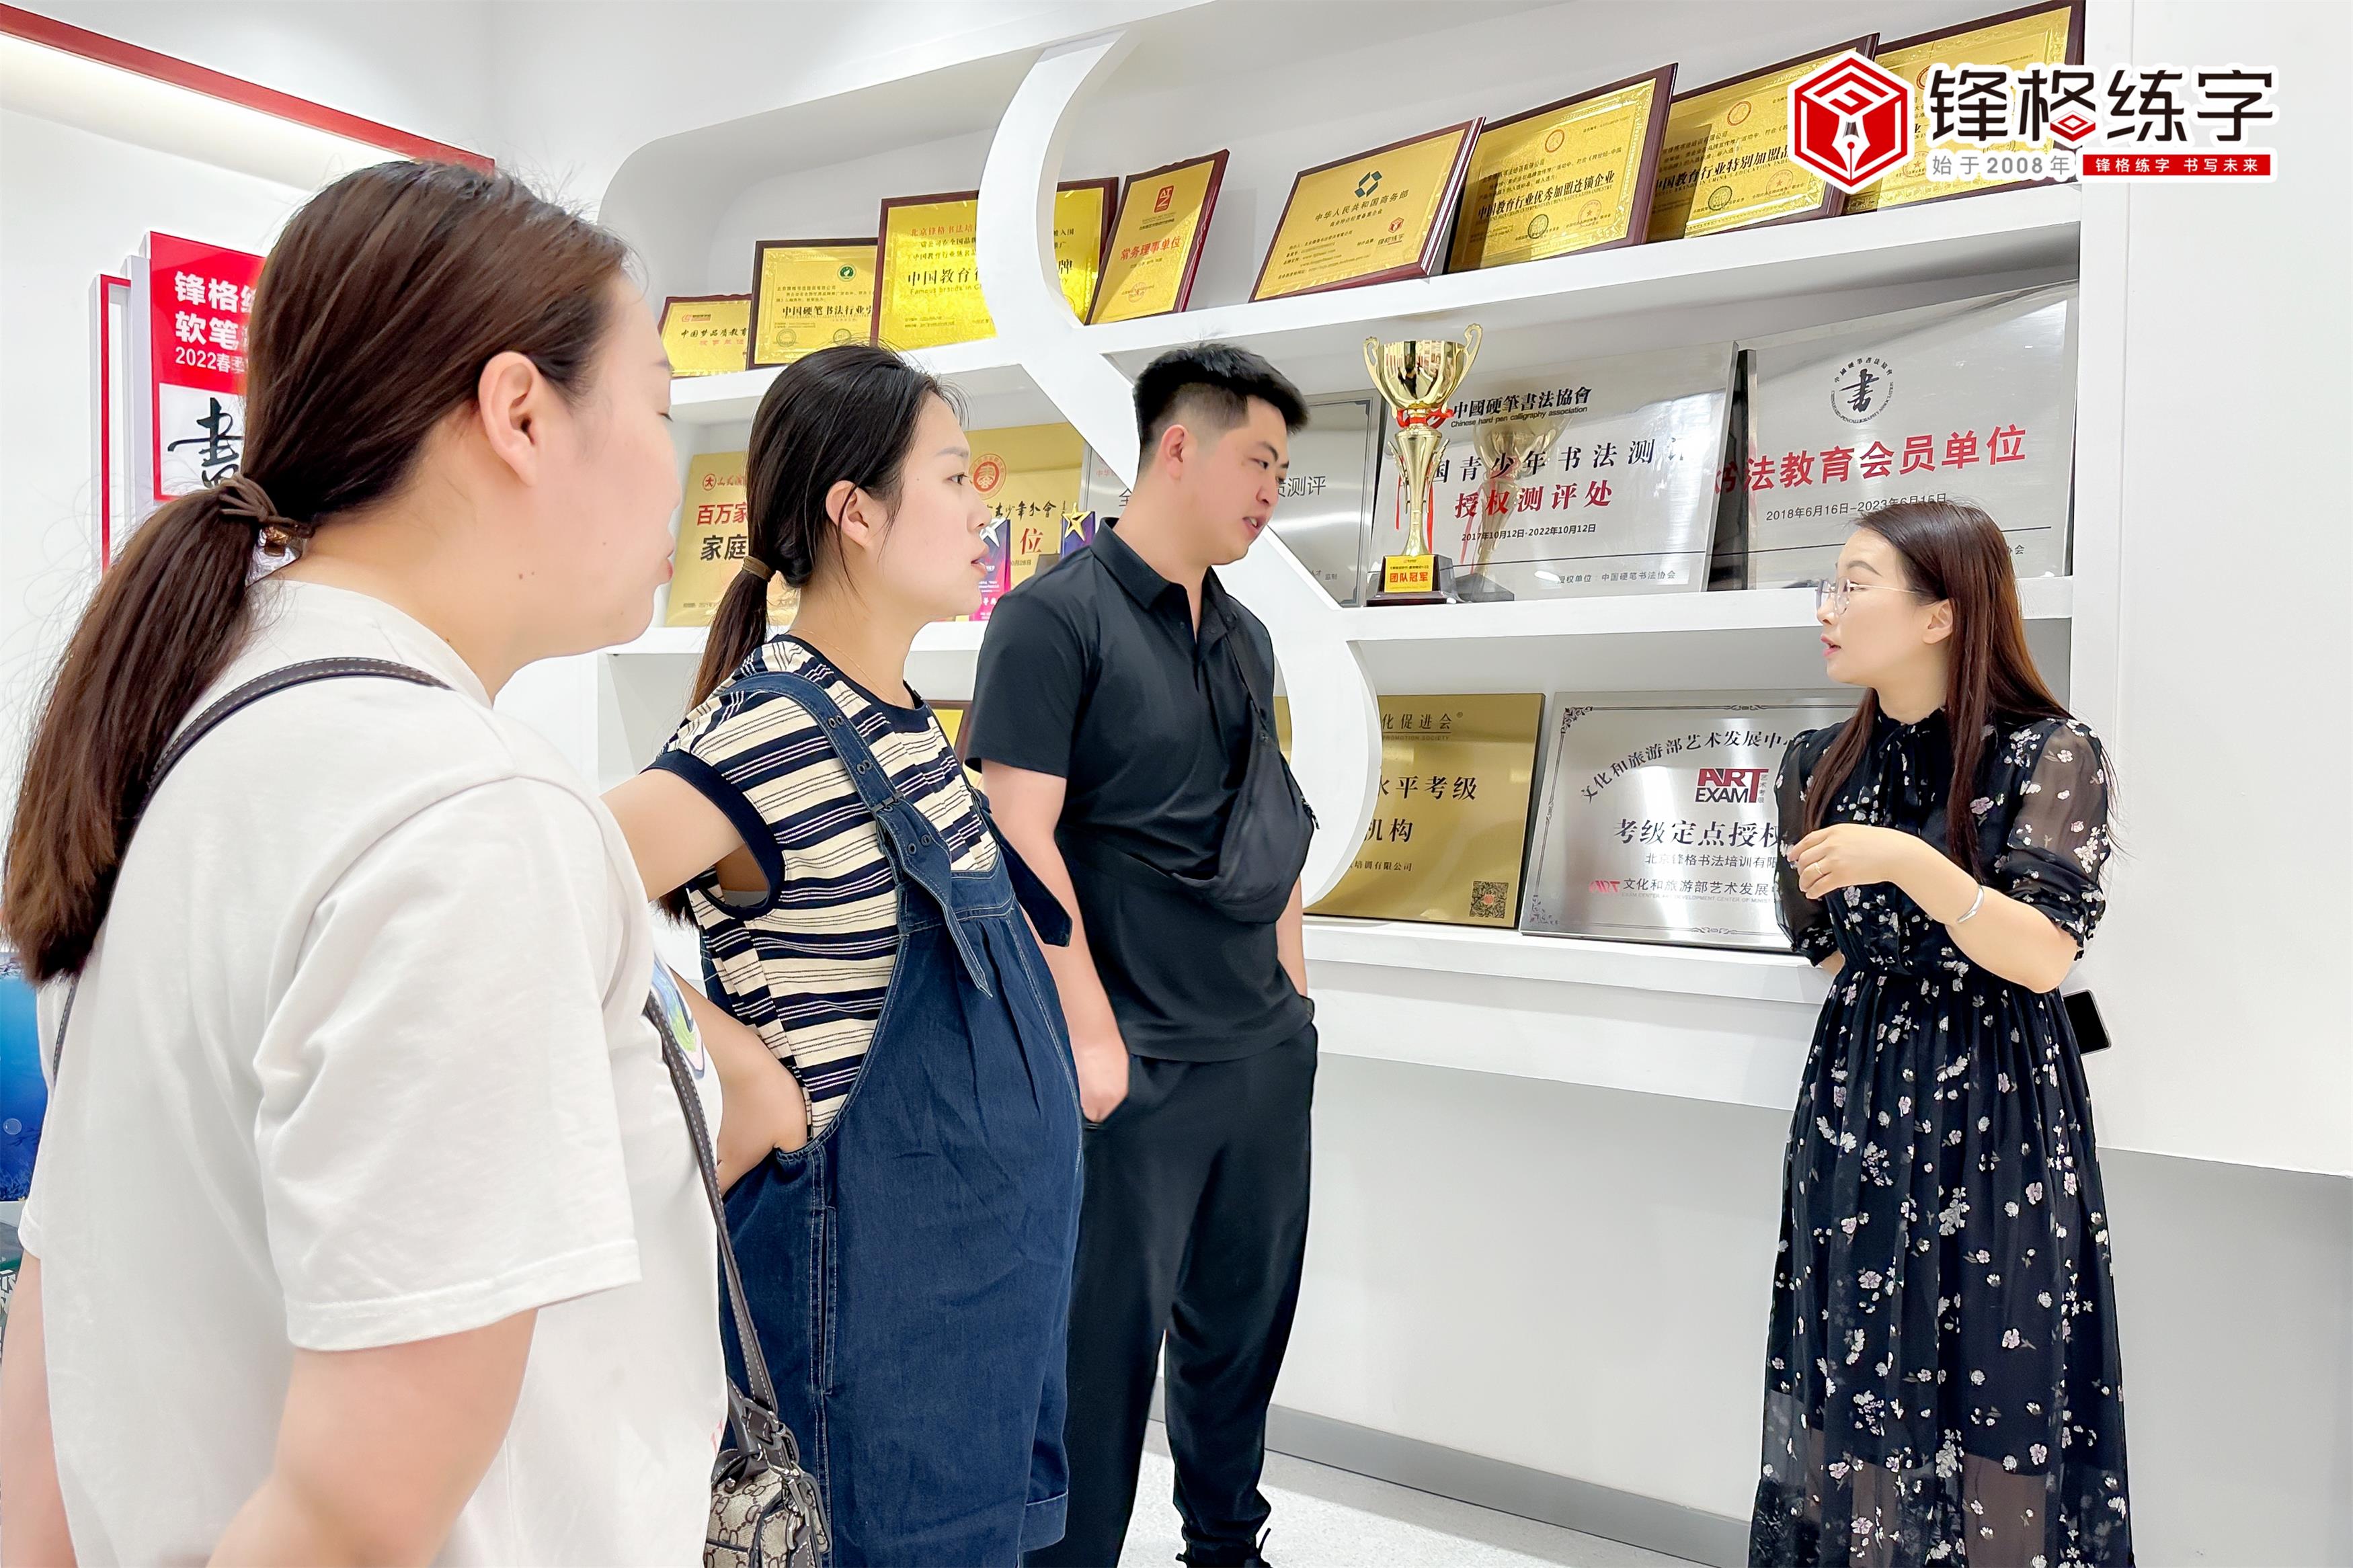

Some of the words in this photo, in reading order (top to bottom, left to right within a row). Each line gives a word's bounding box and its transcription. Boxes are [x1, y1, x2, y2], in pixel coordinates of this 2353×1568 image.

[1315, 189, 1410, 222] 中华人民共和国商务部
[1120, 235, 1181, 261] 常务理事单位
[175, 311, 248, 353] 软笔
[175, 346, 249, 374] 2022春季
[1451, 419, 1476, 428] Chinese
[1478, 416, 1494, 426] hard
[1495, 417, 1508, 425] pen
[1510, 411, 1547, 422] calligraphy
[1548, 405, 1588, 417] association
[1454, 479, 1613, 520] 授权测评处
[700, 534, 748, 561] 家庭
[1020, 528, 1044, 555] 位
[1389, 571, 1429, 583] 团队冠军
[1382, 713, 1452, 730] 化促进会
[1581, 730, 1790, 804] 文化和旅游部艺术发展中
[1695, 787, 1749, 803] EXAM
[1697, 768, 1769, 803] ART
[1613, 819, 1779, 848] 考级定点授权
[1350, 860, 1412, 872] 培训有限公司
[1622, 877, 1776, 897] 文化和旅游部艺术发展
